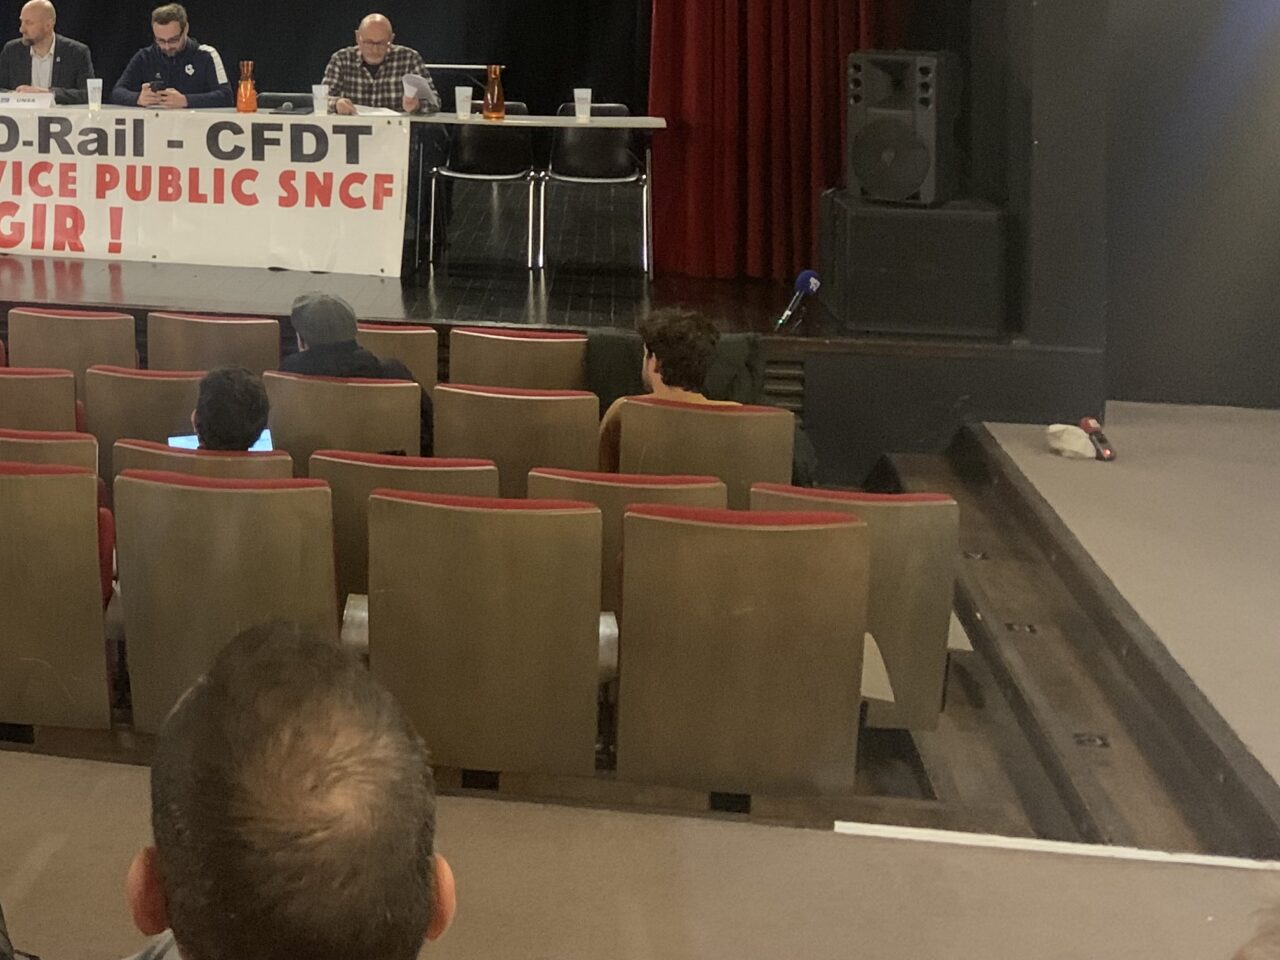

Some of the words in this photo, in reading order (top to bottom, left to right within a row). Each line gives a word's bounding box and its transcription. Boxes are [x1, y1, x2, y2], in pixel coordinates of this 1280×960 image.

[167, 139, 184, 149] -
[206, 120, 373, 165] CFDT
[95, 163, 260, 207] PUBLIC
[277, 169, 395, 211] SNCF
[106, 206, 123, 255] !
